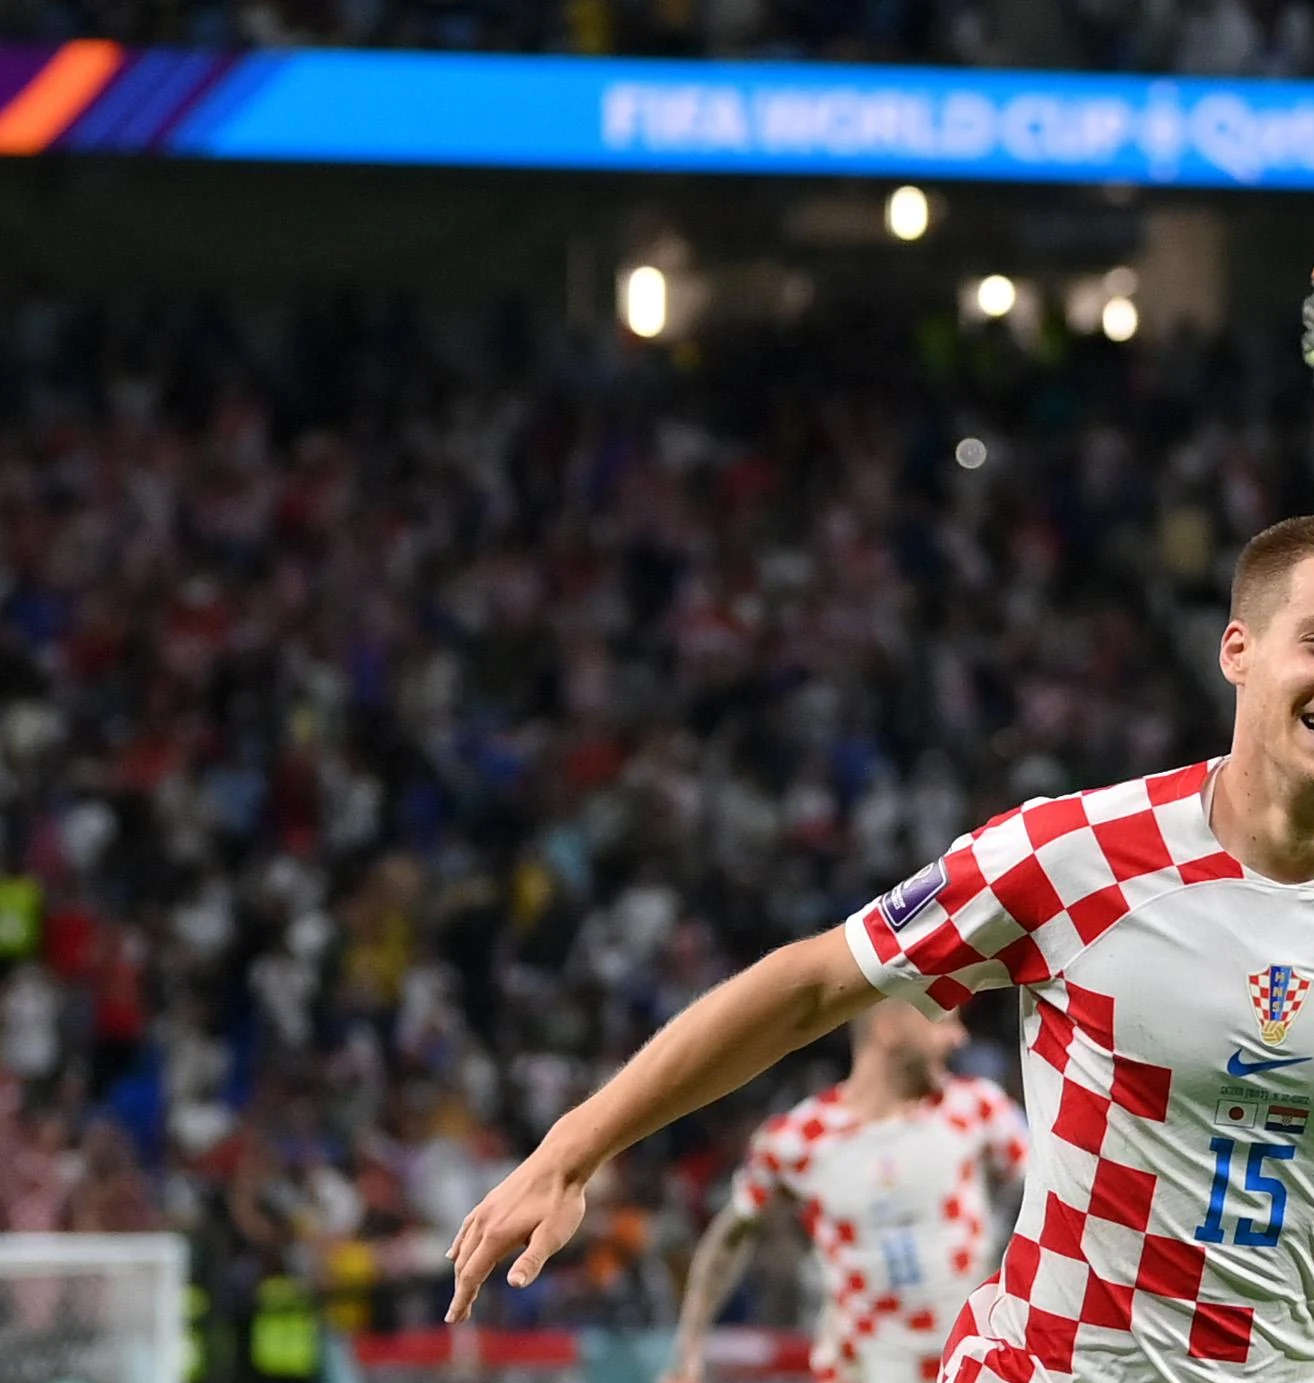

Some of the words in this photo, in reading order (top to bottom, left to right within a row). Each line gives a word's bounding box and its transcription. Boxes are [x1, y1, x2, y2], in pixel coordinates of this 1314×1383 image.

[601, 82, 749, 149] FIFA
[753, 87, 995, 158] WORLD
[1000, 94, 1130, 162] CUP
[1194, 1136, 1296, 1247] 15
